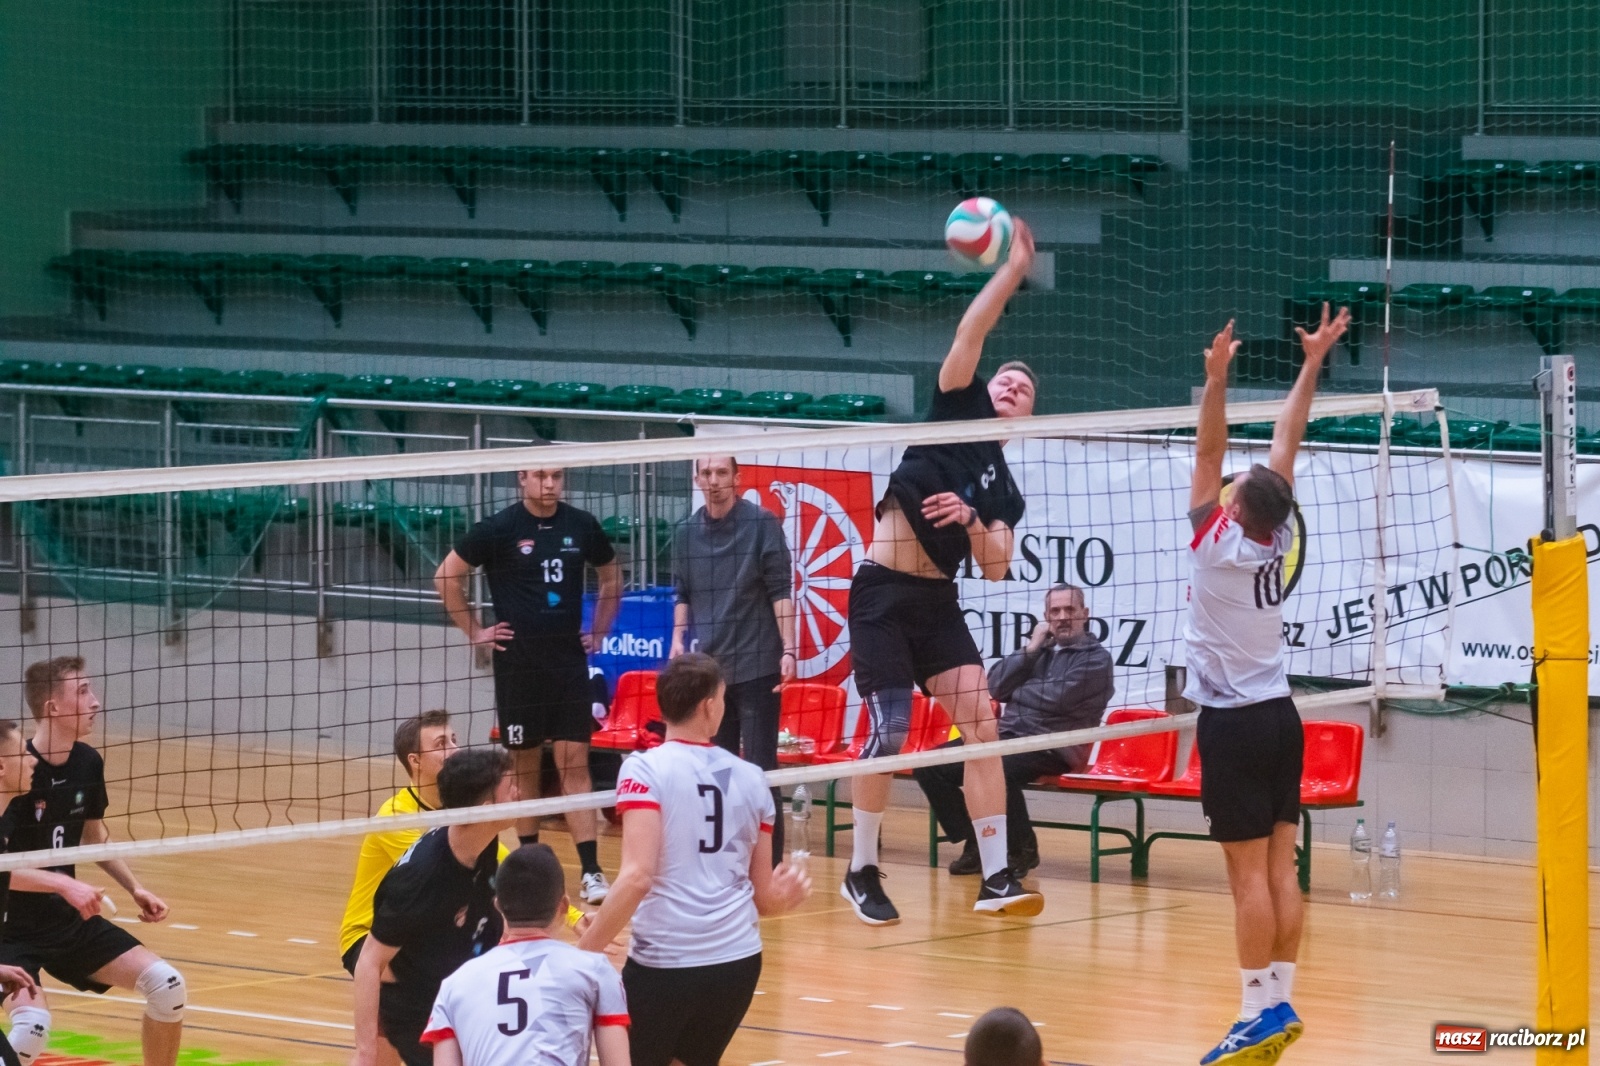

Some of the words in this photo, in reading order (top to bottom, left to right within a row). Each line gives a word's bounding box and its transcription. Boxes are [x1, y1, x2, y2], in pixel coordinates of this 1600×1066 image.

[540, 558, 564, 583] 13
[1253, 555, 1284, 609] 10
[1417, 572, 1453, 610] W
[506, 724, 524, 745] 13
[52, 825, 65, 849] 6
[696, 783, 724, 854] 3
[496, 968, 531, 1037] 5
